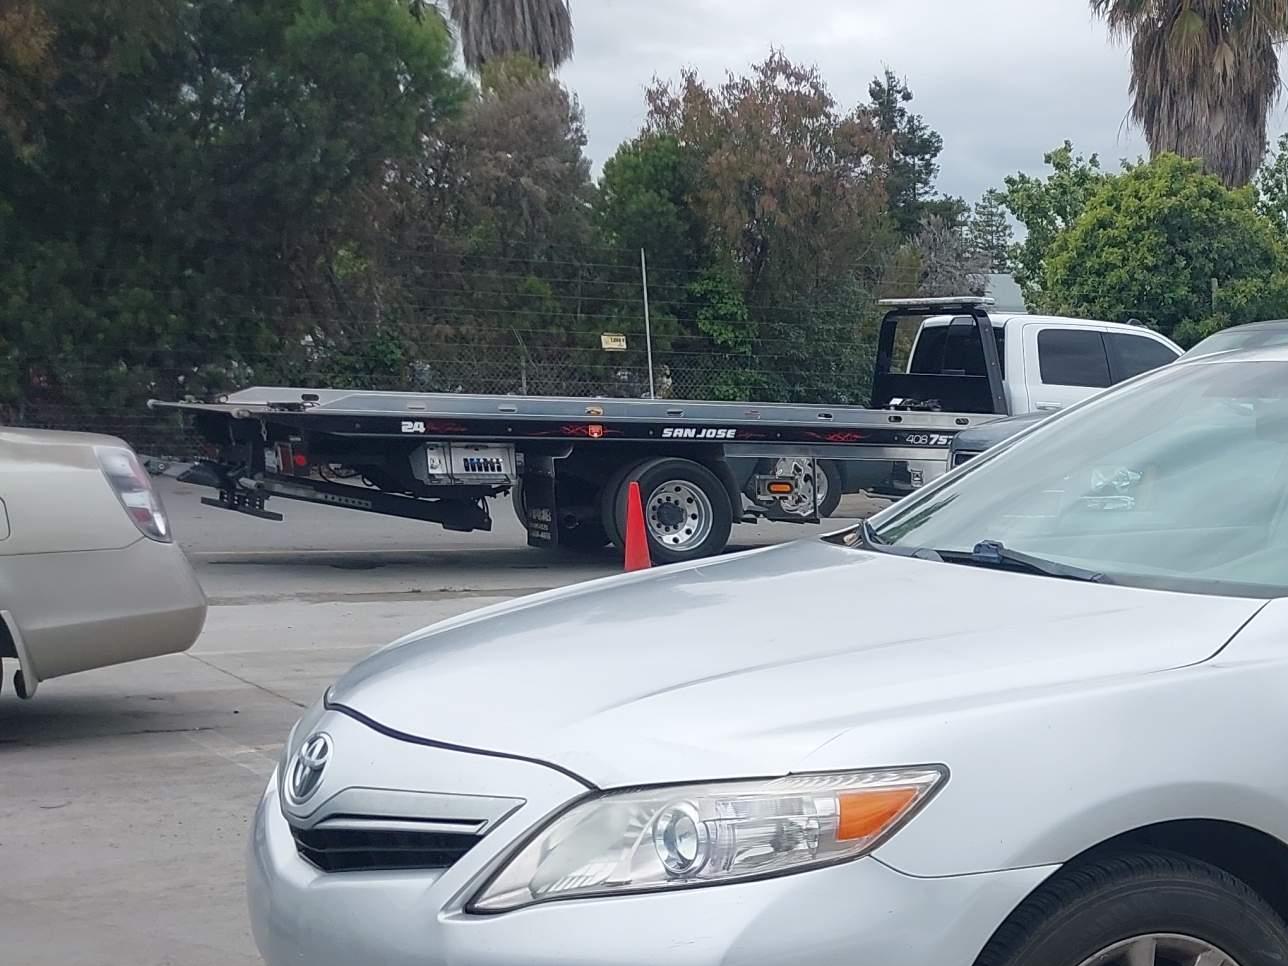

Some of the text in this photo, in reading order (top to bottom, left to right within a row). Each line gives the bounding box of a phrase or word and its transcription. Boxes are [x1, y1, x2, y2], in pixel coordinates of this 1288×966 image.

[401, 421, 426, 433] 24
[662, 428, 696, 438] SAN
[696, 428, 737, 439] JOSE
[906, 434, 928, 444] 408
